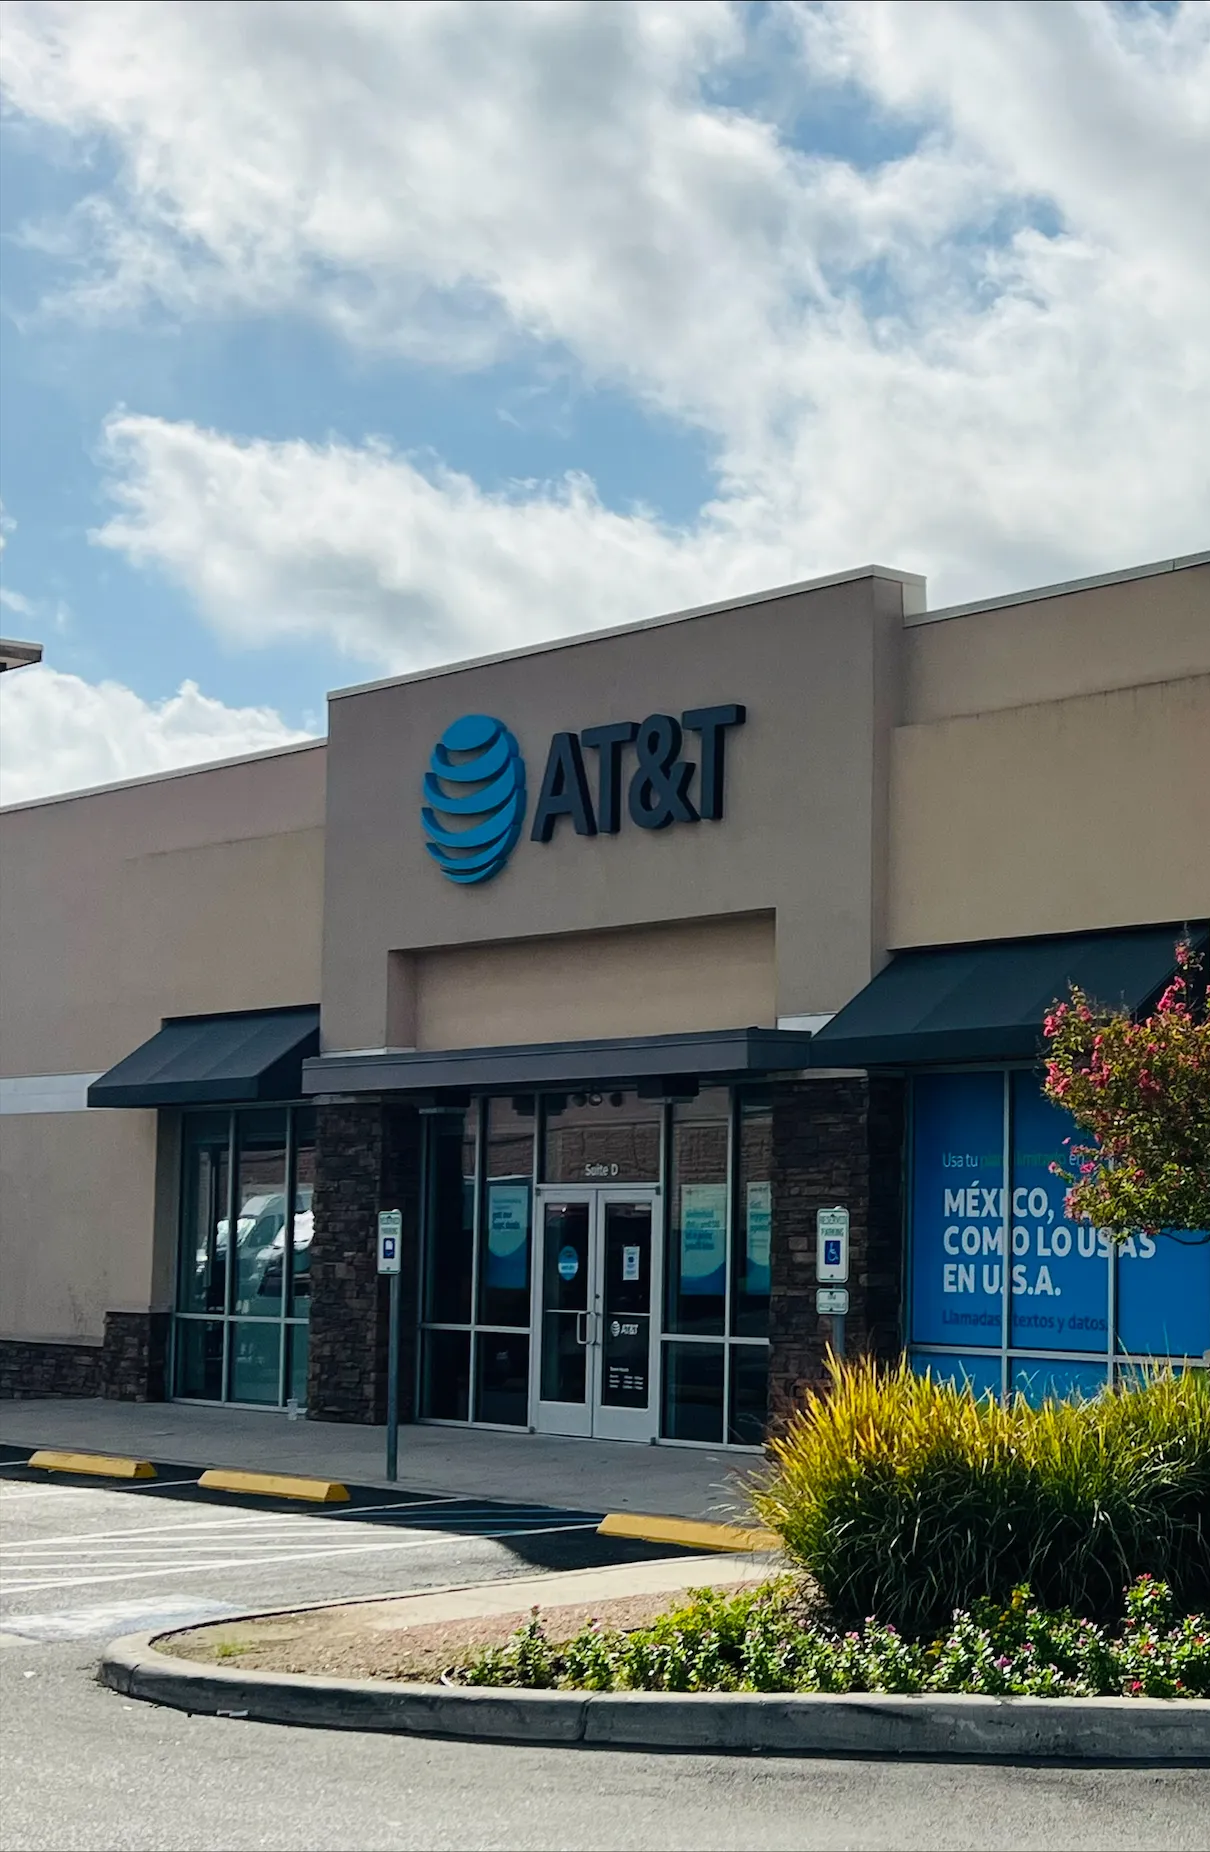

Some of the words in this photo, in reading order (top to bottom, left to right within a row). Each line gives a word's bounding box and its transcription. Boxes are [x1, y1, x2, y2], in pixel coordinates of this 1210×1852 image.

[531, 704, 746, 842] AT&T
[585, 1163, 609, 1177] Suite
[611, 1164, 619, 1177] D
[943, 1152, 964, 1168] Usa
[966, 1153, 979, 1168] tu
[944, 1180, 1055, 1225] MÉXICO,
[943, 1225, 1030, 1257] COMO
[1037, 1226, 1072, 1258] LO
[1077, 1226, 1156, 1259] USAS
[943, 1263, 975, 1294] EN
[983, 1263, 1062, 1297] U.S.A.
[1013, 1312, 1055, 1329] textos
[1058, 1317, 1066, 1334] y
